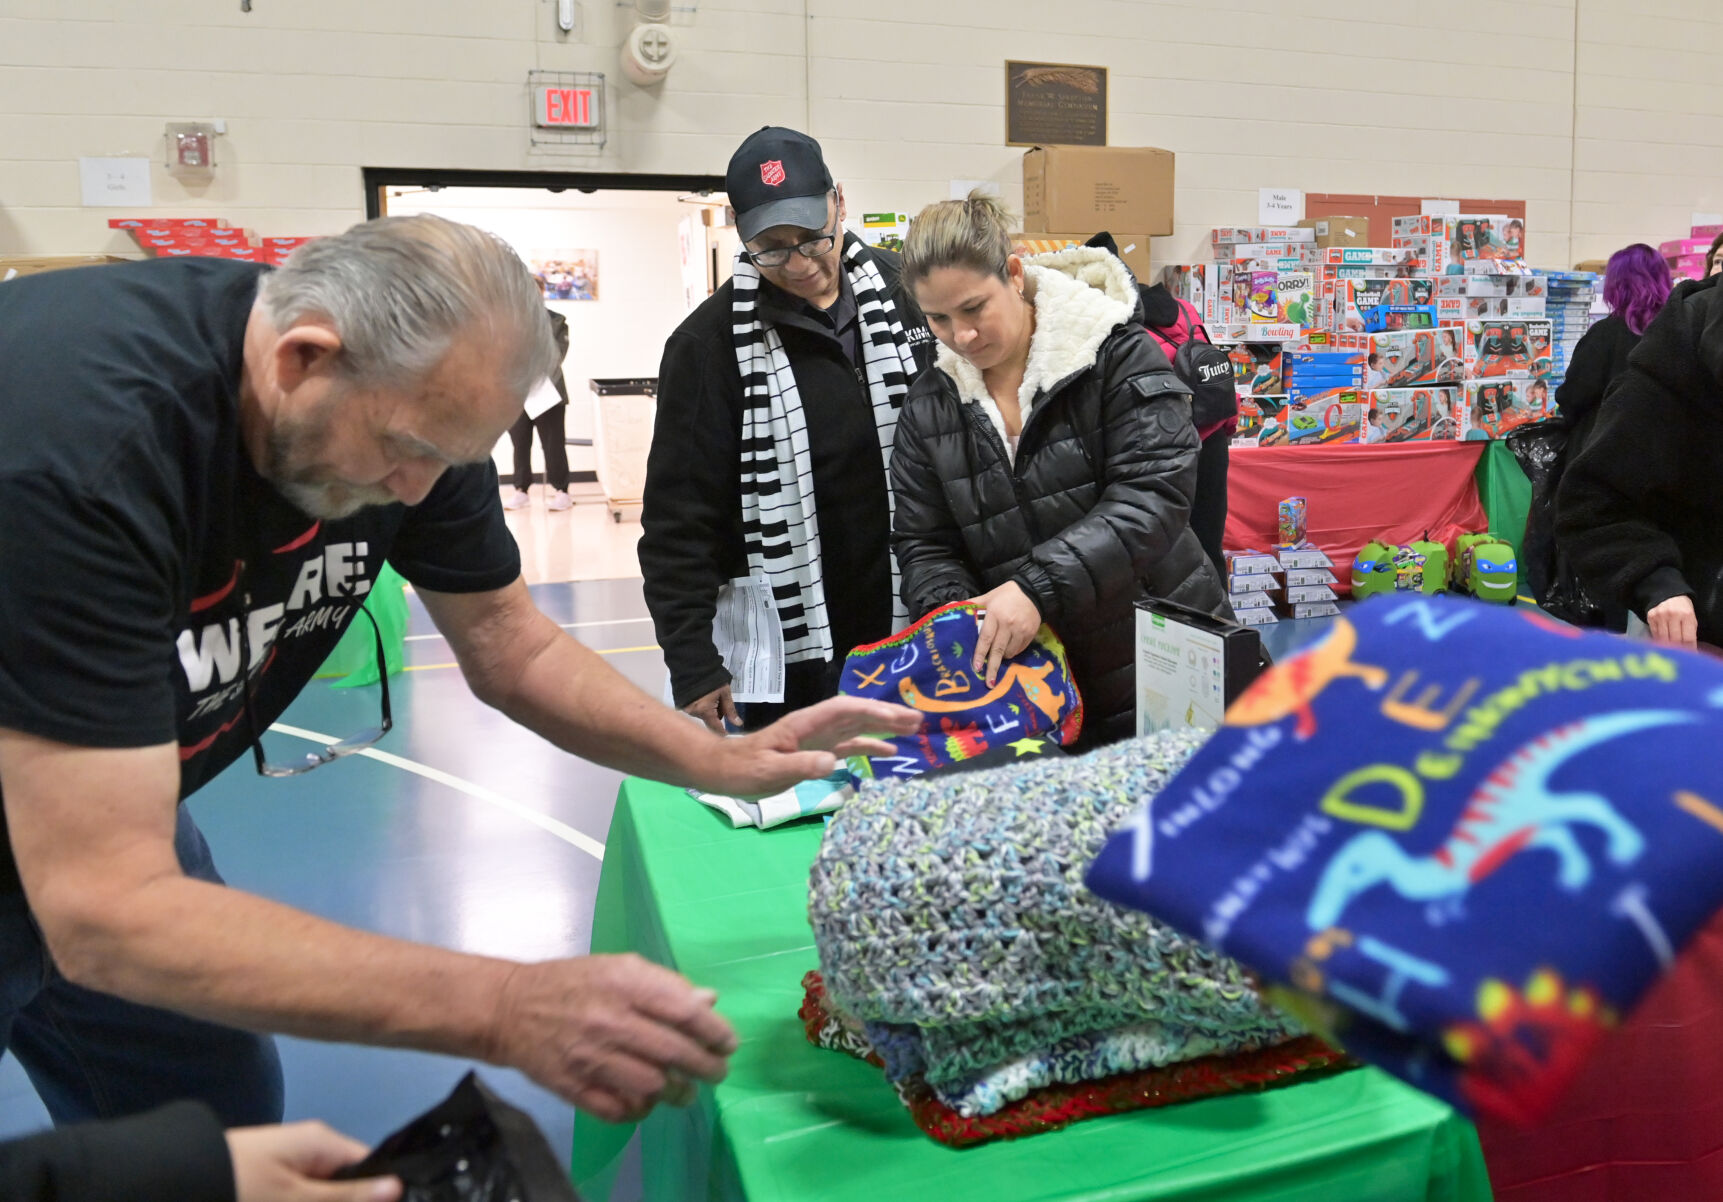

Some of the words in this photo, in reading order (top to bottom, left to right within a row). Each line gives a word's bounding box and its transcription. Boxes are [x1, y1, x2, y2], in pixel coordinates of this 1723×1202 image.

[546, 89, 591, 125] EXIT
[1278, 279, 1309, 291] ORRY!
[1356, 297, 1379, 305] GAME
[1440, 300, 1461, 308] GAME
[1261, 327, 1294, 339] Bowling
[1529, 329, 1548, 337] GAME
[1198, 361, 1229, 382] Juicy
[1455, 406, 1463, 437] GAME
[283, 604, 350, 639] ARMY
